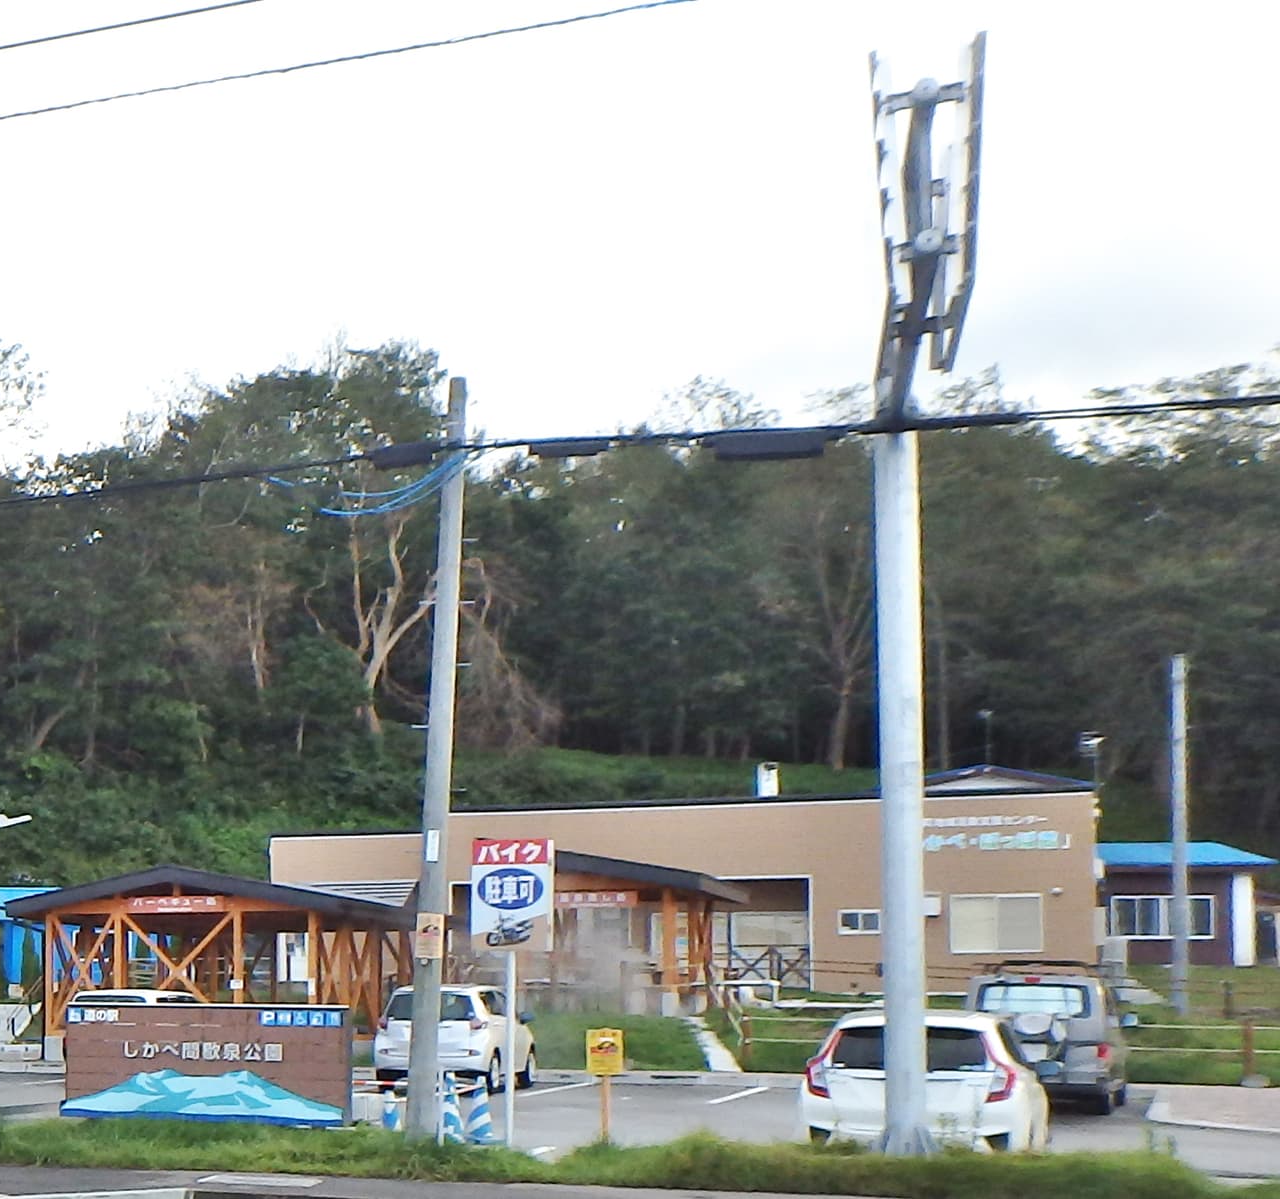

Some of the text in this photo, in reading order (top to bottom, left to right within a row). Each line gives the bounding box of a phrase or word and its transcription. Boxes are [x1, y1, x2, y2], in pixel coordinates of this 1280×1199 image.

[477, 842, 542, 863] バイク
[484, 875, 536, 904] 駐車可
